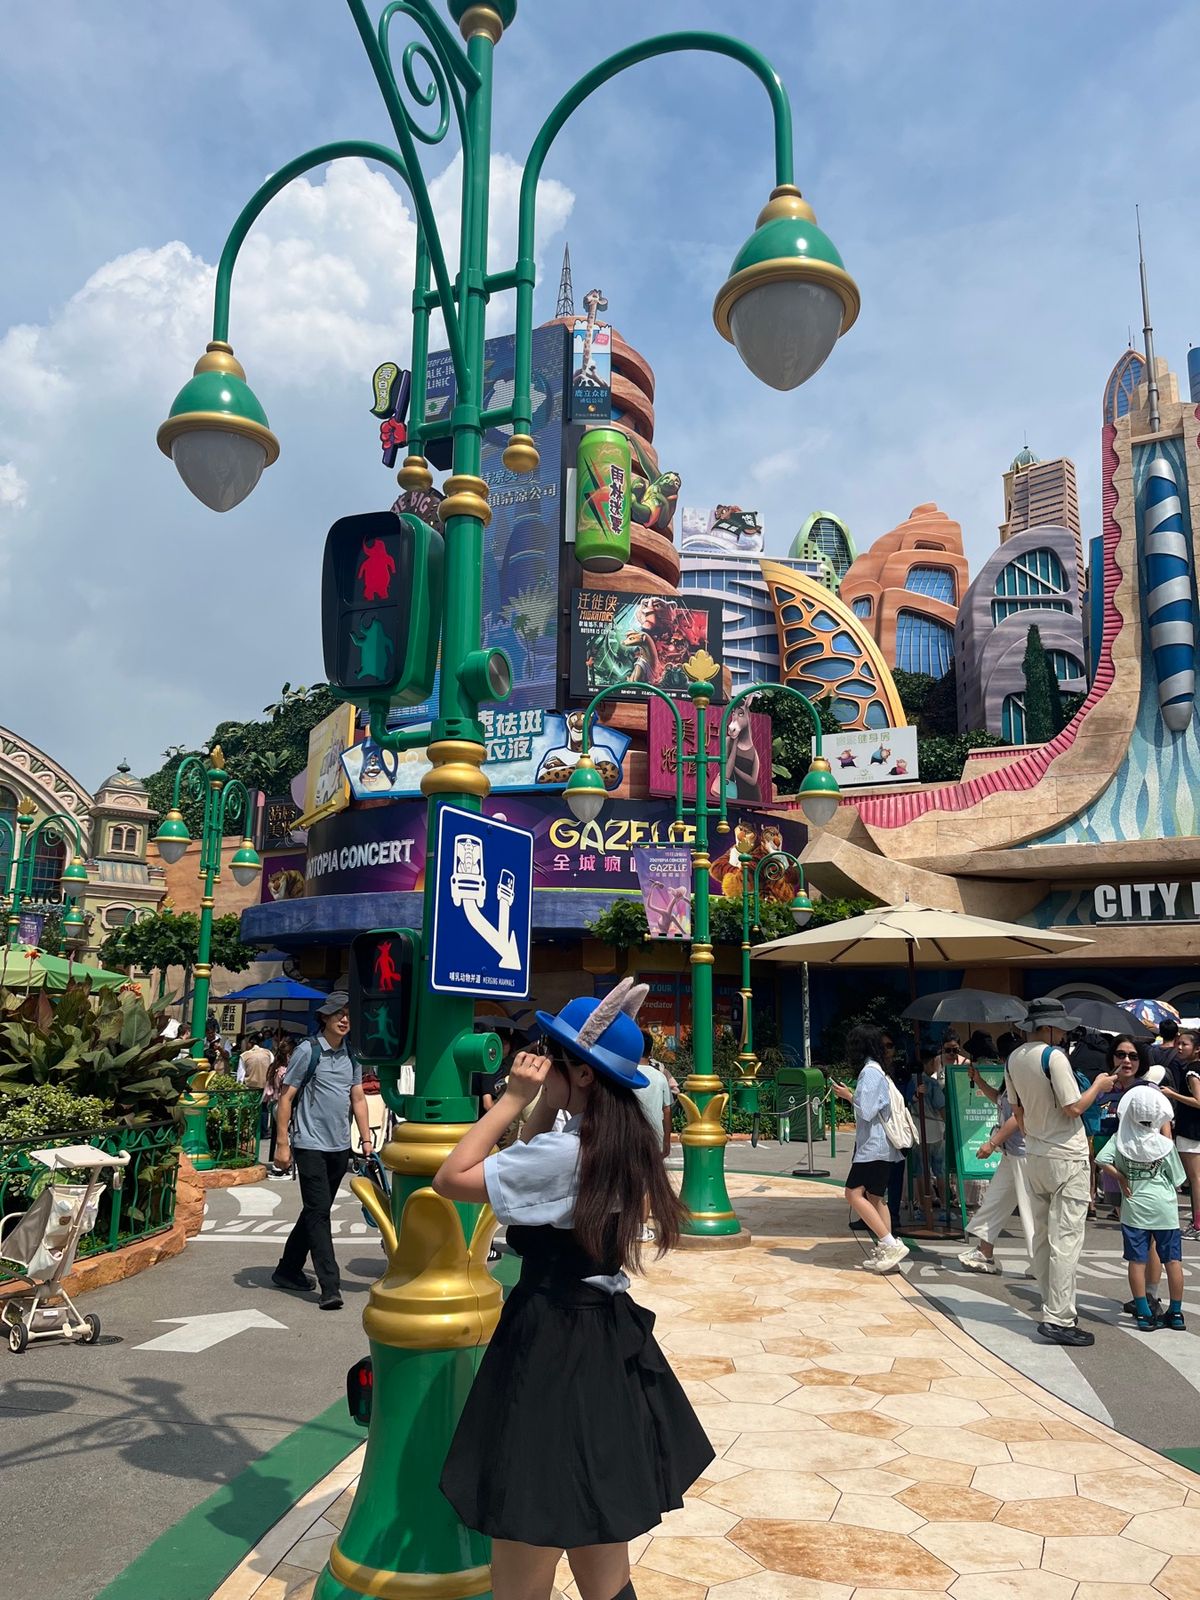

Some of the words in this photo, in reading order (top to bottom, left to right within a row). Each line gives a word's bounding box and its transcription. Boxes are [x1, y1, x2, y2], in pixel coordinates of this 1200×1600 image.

[427, 365, 455, 379] ALK-IN
[427, 377, 450, 389] LINIC
[410, 491, 431, 514] BIG
[549, 818, 697, 855] GAZELLE
[340, 839, 415, 870] CONCERT
[648, 863, 688, 872] GAZELLE
[1093, 882, 1180, 919] CITY
